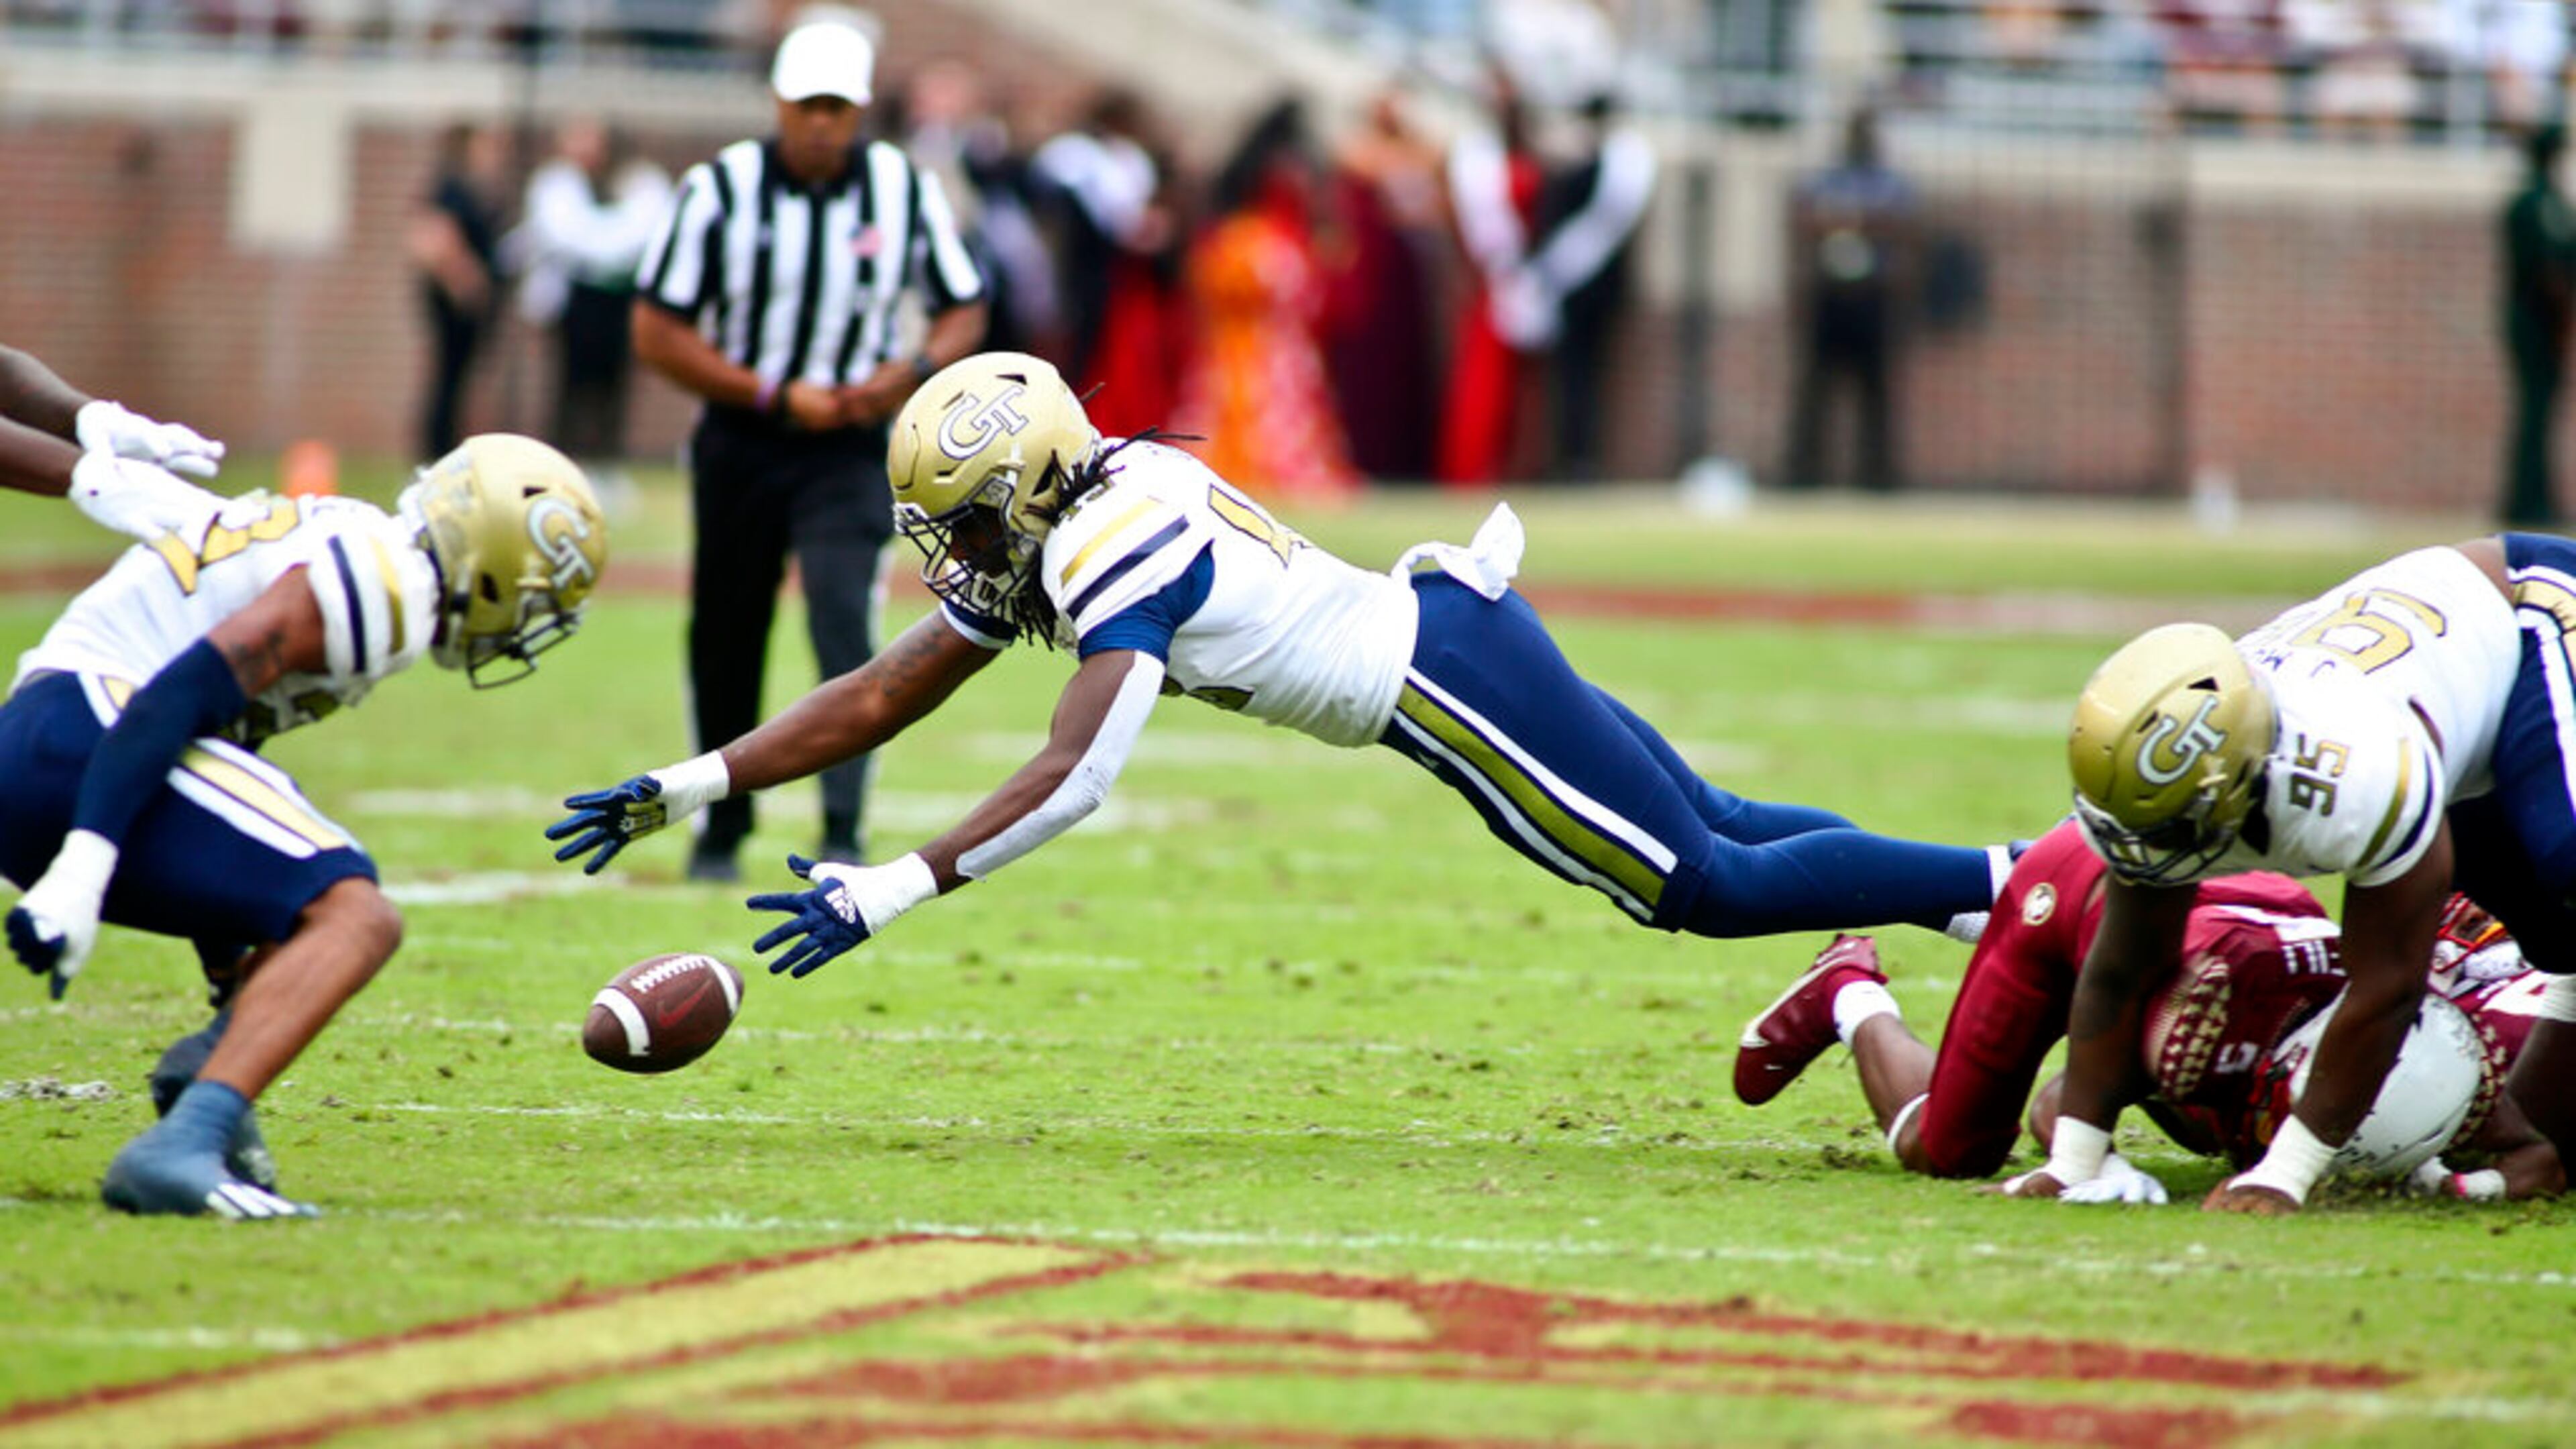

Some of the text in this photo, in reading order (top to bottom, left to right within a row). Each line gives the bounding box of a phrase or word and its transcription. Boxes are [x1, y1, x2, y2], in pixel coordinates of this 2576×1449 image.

[938, 385, 1029, 461] GT
[526, 496, 596, 590] GT
[2136, 694, 2229, 787] GT
[2289, 731, 2351, 818] 95
